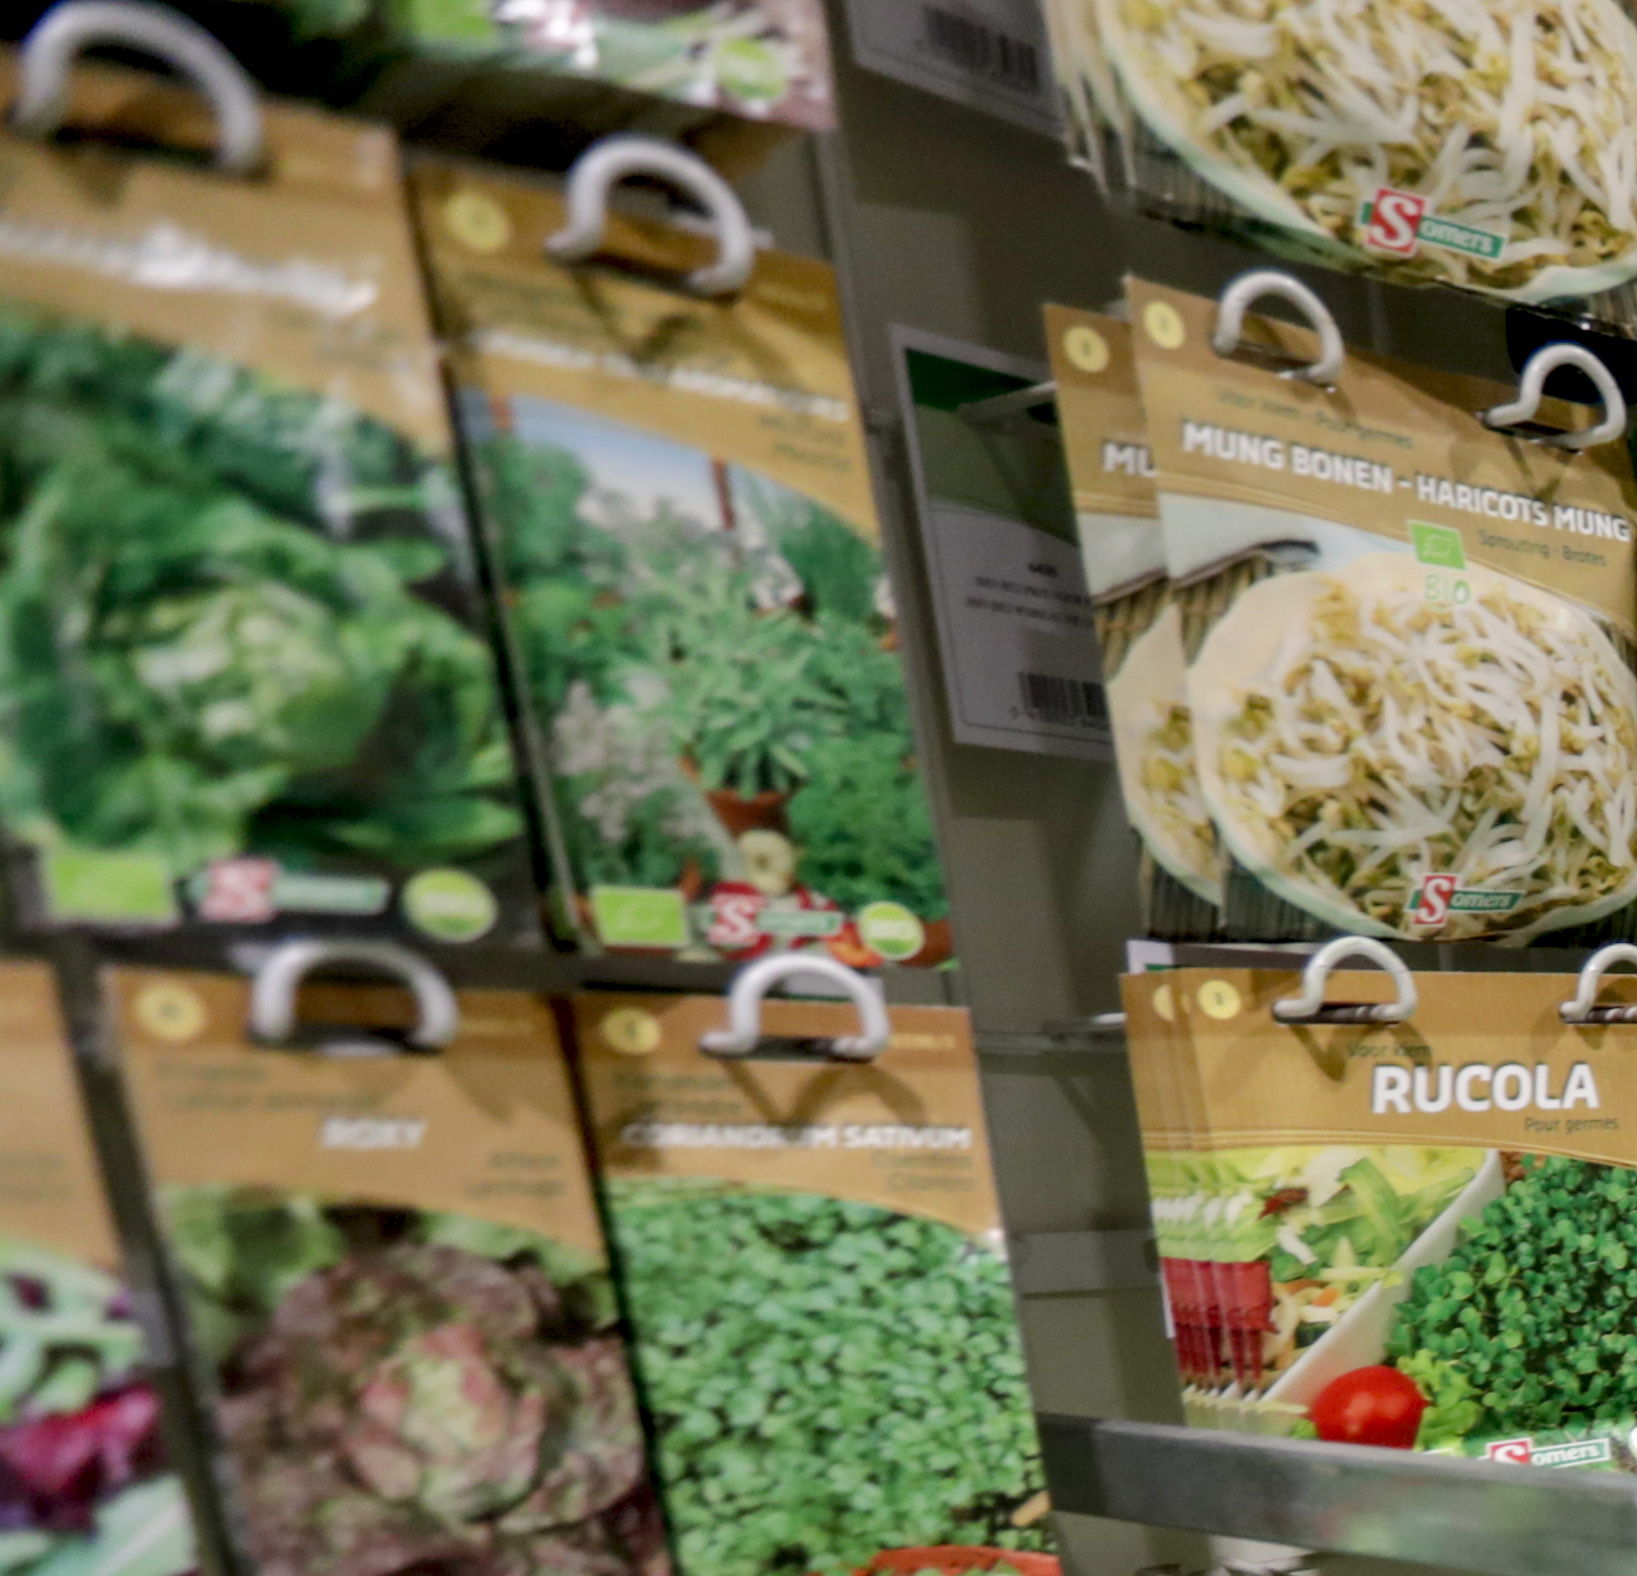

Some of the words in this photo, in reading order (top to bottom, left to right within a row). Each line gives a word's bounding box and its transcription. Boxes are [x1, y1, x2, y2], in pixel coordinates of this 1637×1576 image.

[1364, 189, 1502, 258] Somers
[1181, 420, 1286, 469] MUNG
[1291, 446, 1394, 493] BONEN
[1417, 475, 1549, 527] HARICOTS
[1553, 505, 1632, 543] MUNG
[1423, 573, 1471, 608] BIO
[1407, 873, 1522, 925] Somers
[1371, 1062, 1600, 1115] RUCOLA
